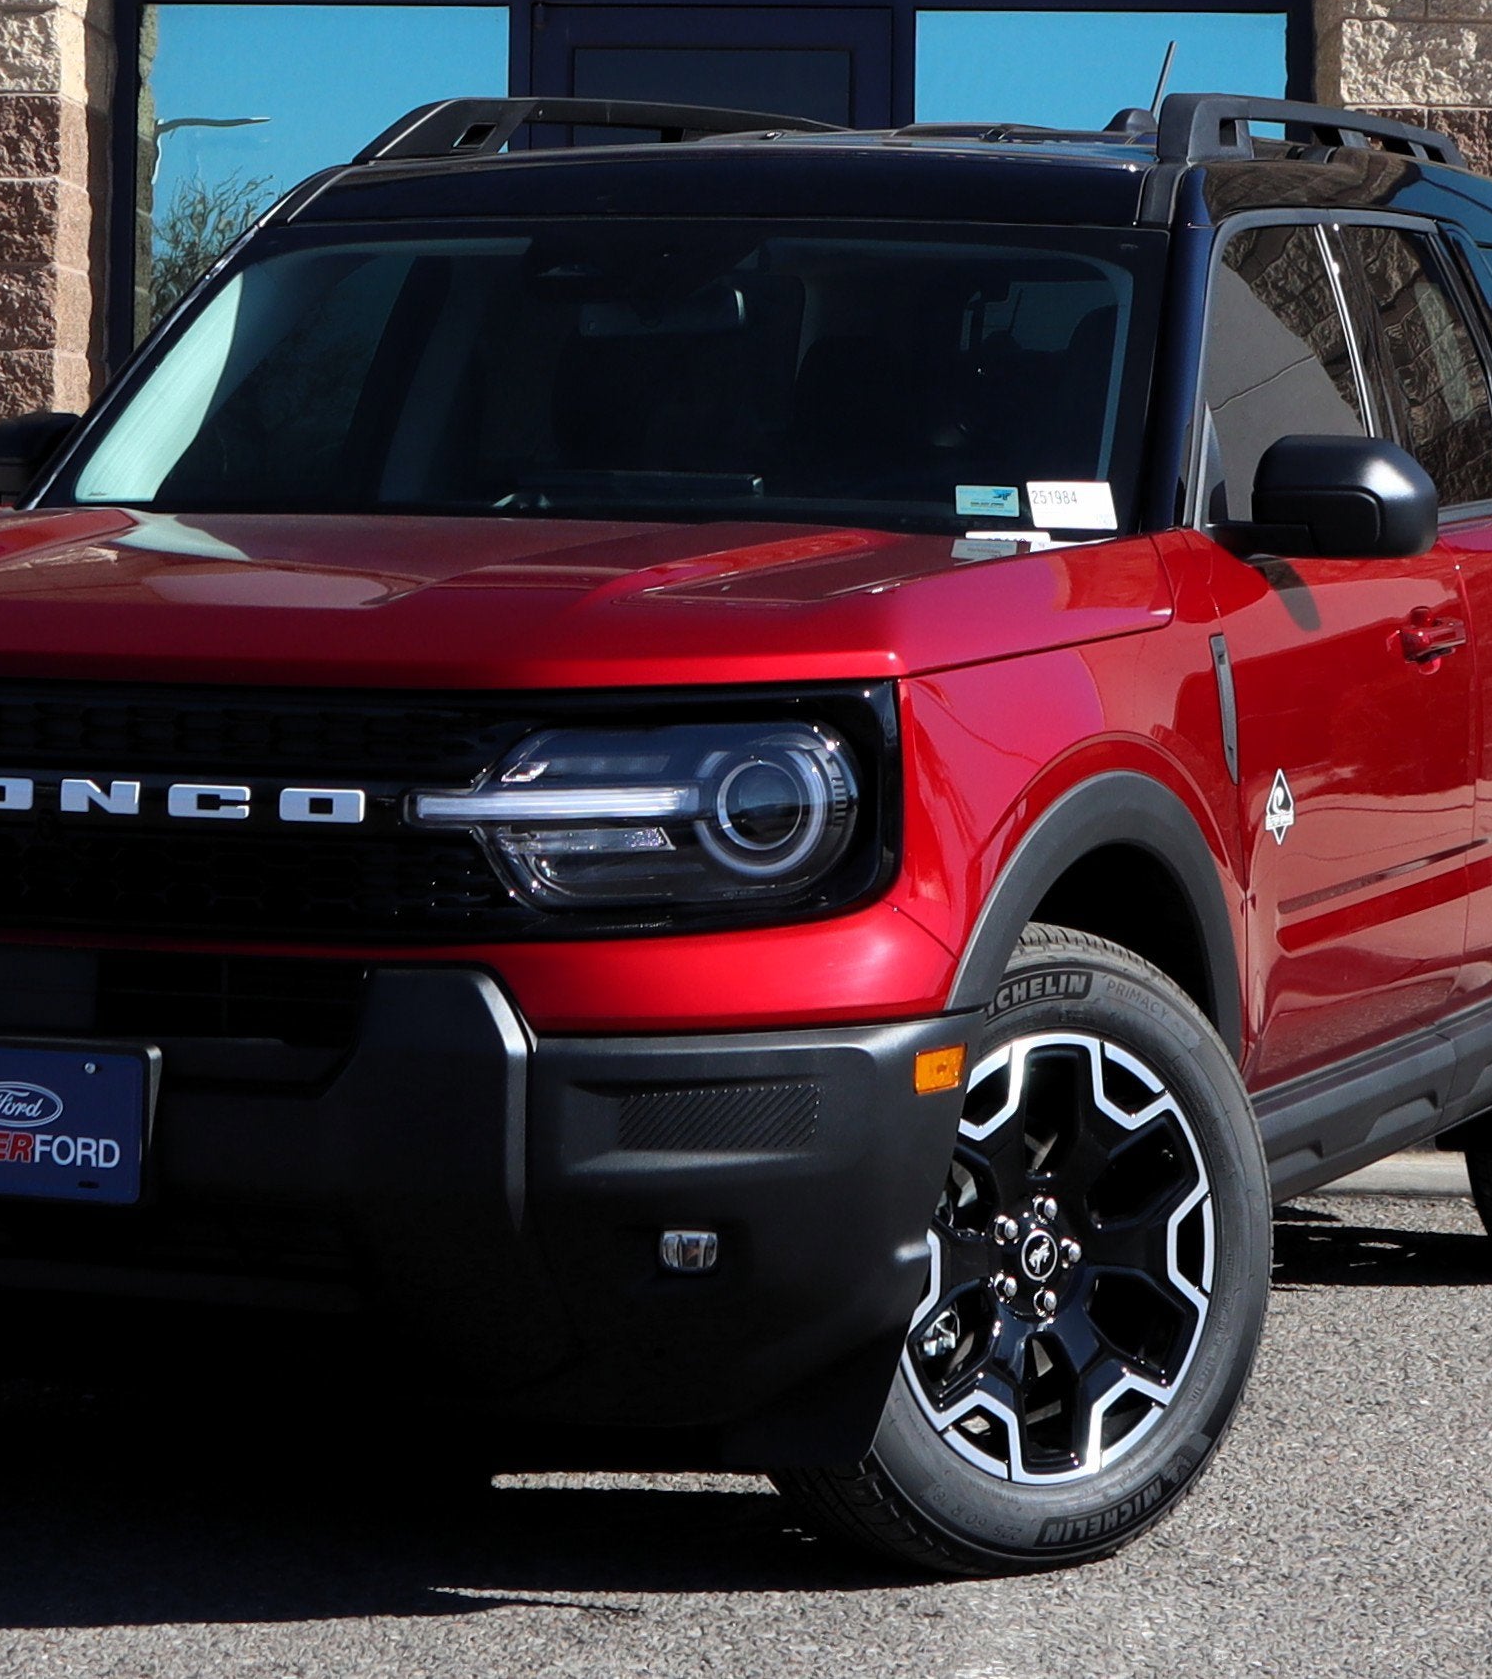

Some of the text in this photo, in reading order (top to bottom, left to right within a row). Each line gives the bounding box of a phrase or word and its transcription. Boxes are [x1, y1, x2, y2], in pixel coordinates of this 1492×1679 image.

[1031, 490, 1077, 505] 251984
[986, 973, 1170, 1020] ICHELIN PRIMACY
[1042, 1474, 1163, 1543] MICHELIN
